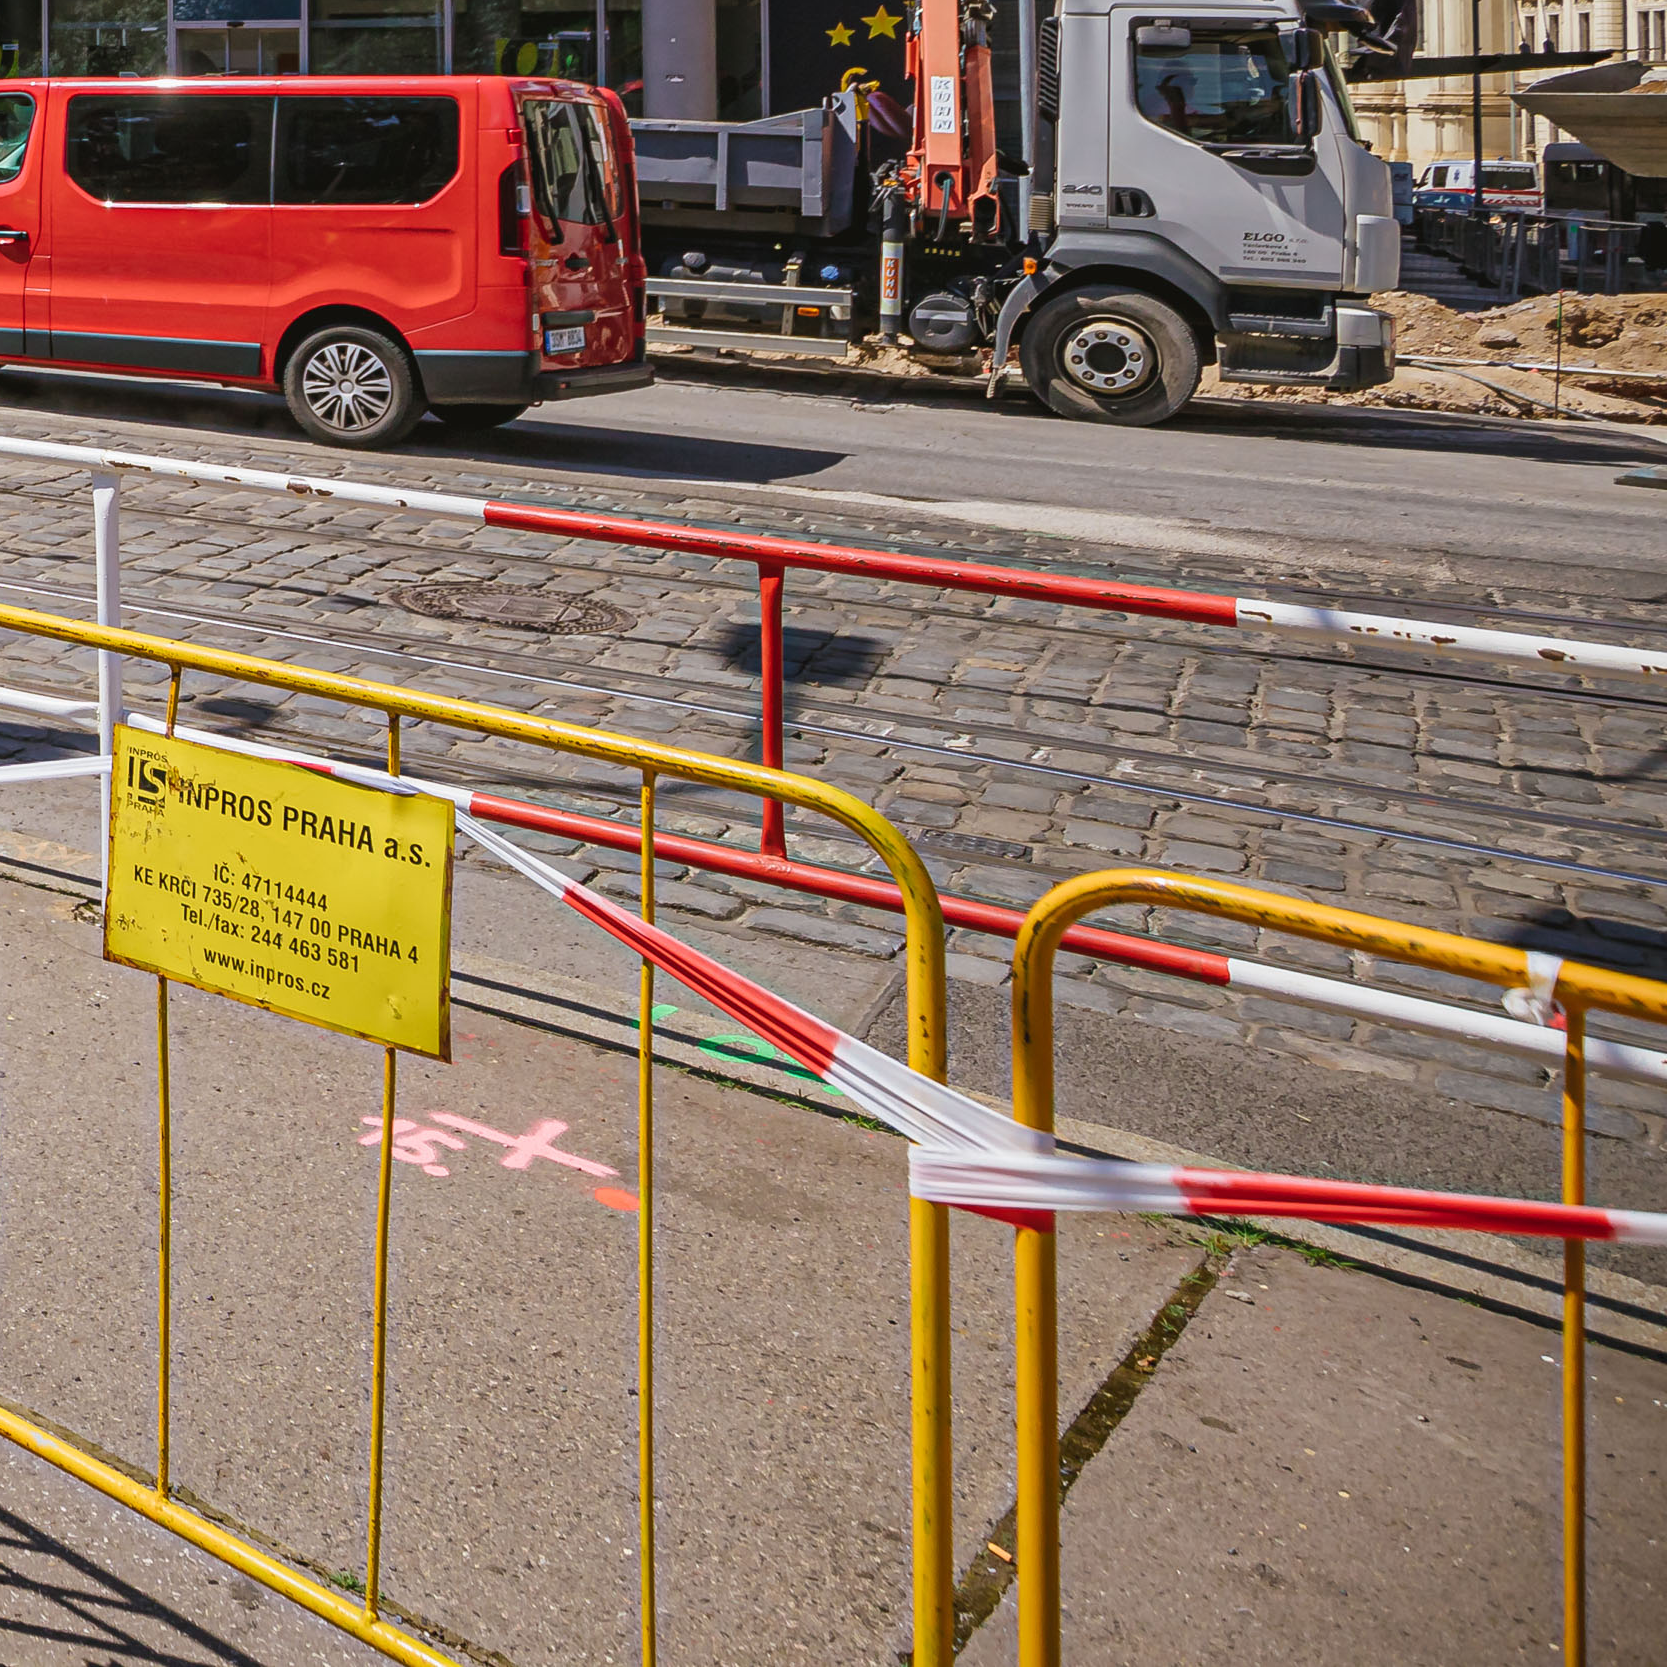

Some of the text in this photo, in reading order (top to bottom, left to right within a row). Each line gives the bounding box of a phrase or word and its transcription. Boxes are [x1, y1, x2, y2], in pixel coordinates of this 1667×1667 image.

[933, 79, 953, 132] KUHN
[1062, 184, 1103, 196] 240
[1243, 232, 1285, 243] ELGO
[885, 258, 897, 299] KUHN
[127, 745, 169, 763] INPROS
[127, 799, 165, 819] PRAHA
[178, 782, 432, 868] INPROS PRAHA a.s.
[213, 862, 329, 912] IČ: 47114444
[134, 864, 154, 887] KE
[202, 884, 266, 922] 735/28,
[272, 905, 305, 933] 147
[309, 916, 332, 940] 00
[337, 924, 402, 961] PRAHA
[407, 944, 419, 965] 4
[180, 903, 360, 974] Tel./fax: 244 463 581
[203, 946, 331, 1001] www.inpros.cz
